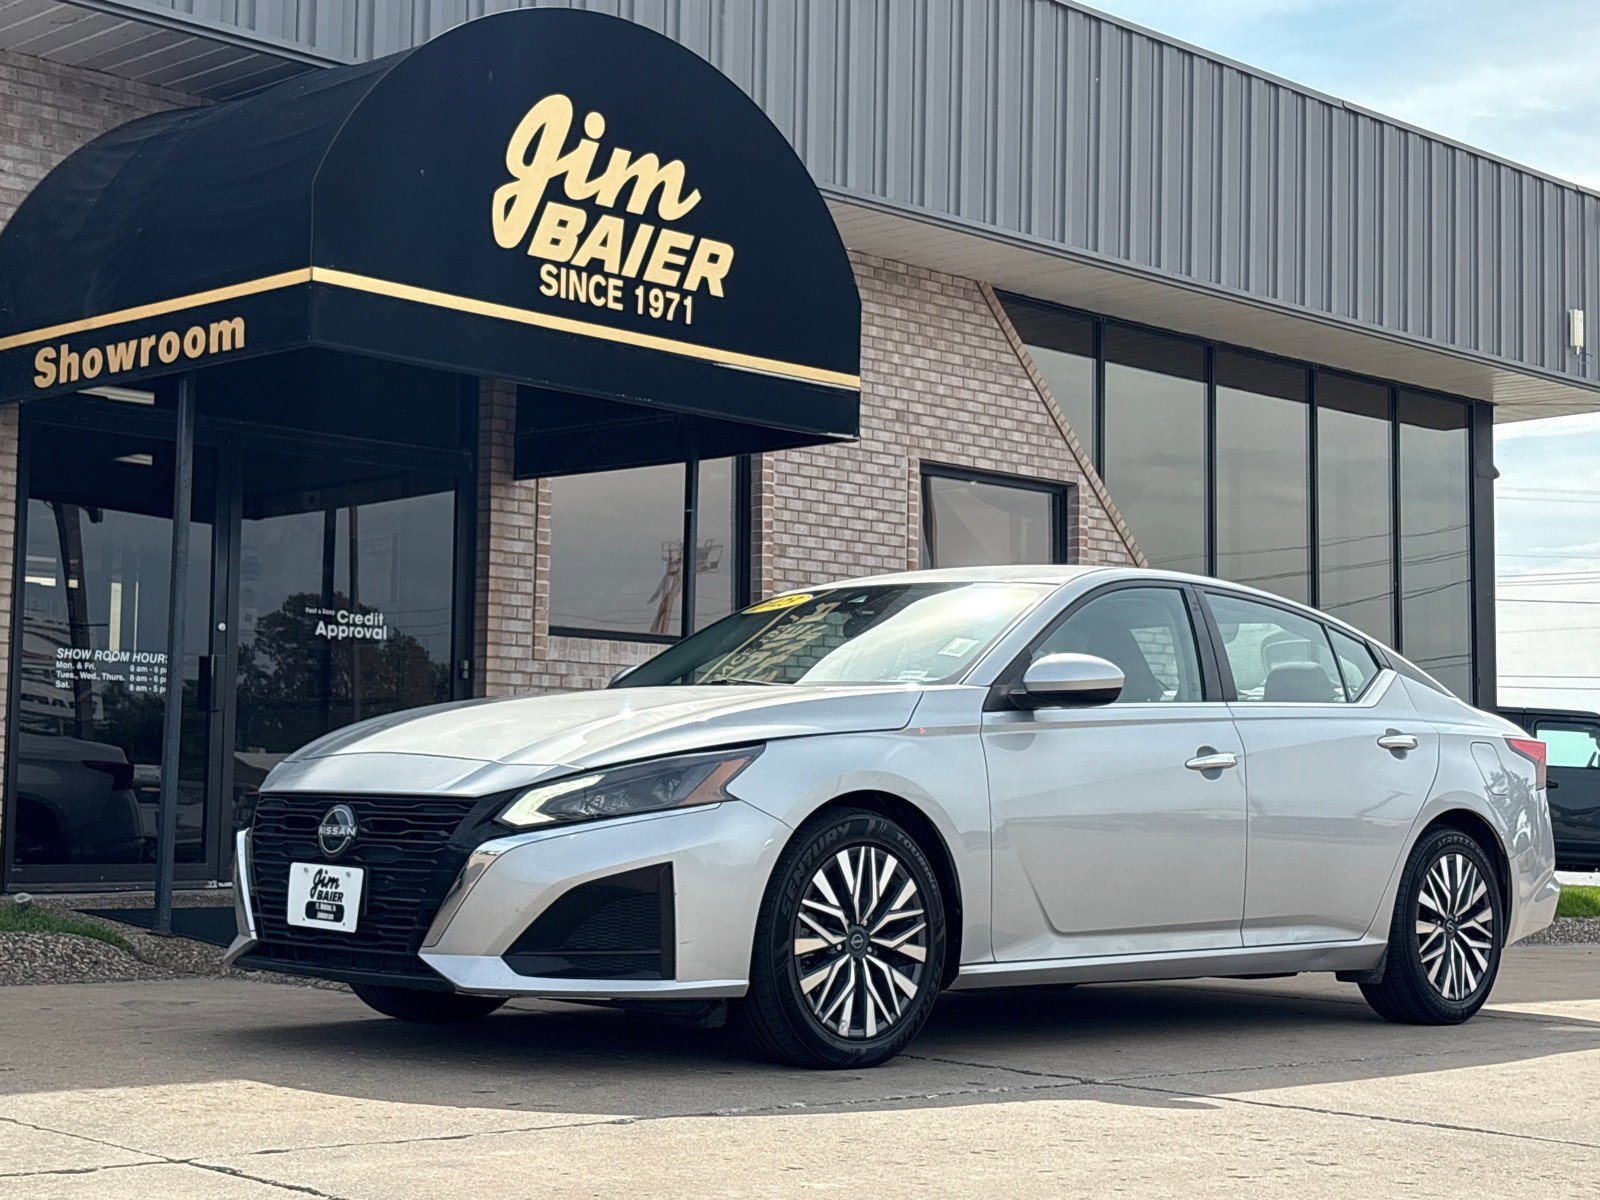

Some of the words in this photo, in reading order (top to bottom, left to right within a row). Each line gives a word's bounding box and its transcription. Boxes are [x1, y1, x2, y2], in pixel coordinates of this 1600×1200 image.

[492, 93, 701, 249] Jim
[527, 201, 734, 297] BAIER
[539, 264, 624, 311] SINCE
[635, 285, 693, 325] 1971
[33, 315, 246, 389] Showroom
[337, 610, 384, 625] Credit
[315, 620, 387, 640] Approval
[56, 648, 92, 660] SHOW
[94, 650, 130, 662] ROOM
[56, 661, 75, 669] Mon.
[160, 667, 167, 675] p
[55, 680, 70, 689] Sat.
[160, 686, 166, 694] p
[160, 676, 167, 685] p
[319, 826, 356, 836] NISSAN
[310, 868, 340, 899] Jim
[317, 890, 344, 903] BAIER
